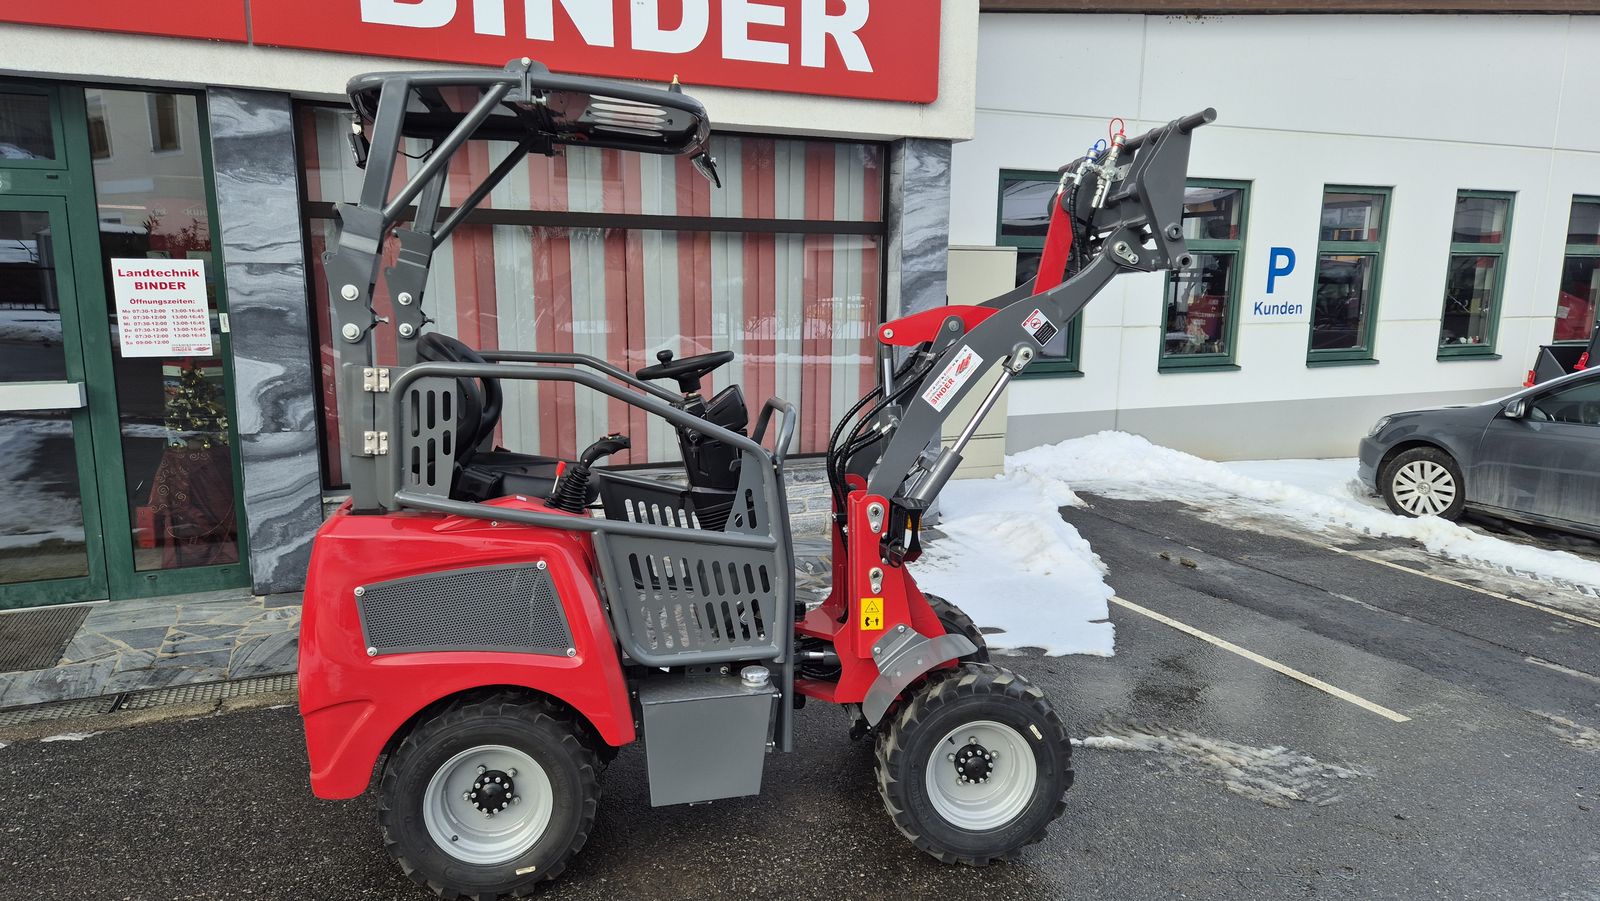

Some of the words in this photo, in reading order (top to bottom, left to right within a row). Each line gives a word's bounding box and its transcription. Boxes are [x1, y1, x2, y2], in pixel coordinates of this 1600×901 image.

[361, 0, 873, 73] DER
[117, 269, 200, 277] Landtechnik
[1266, 247, 1296, 294] P
[134, 281, 187, 290] BINDER
[129, 297, 196, 305] Öffnungszeiten:
[1254, 301, 1303, 316] Kunden
[930, 377, 955, 406] BINDER
